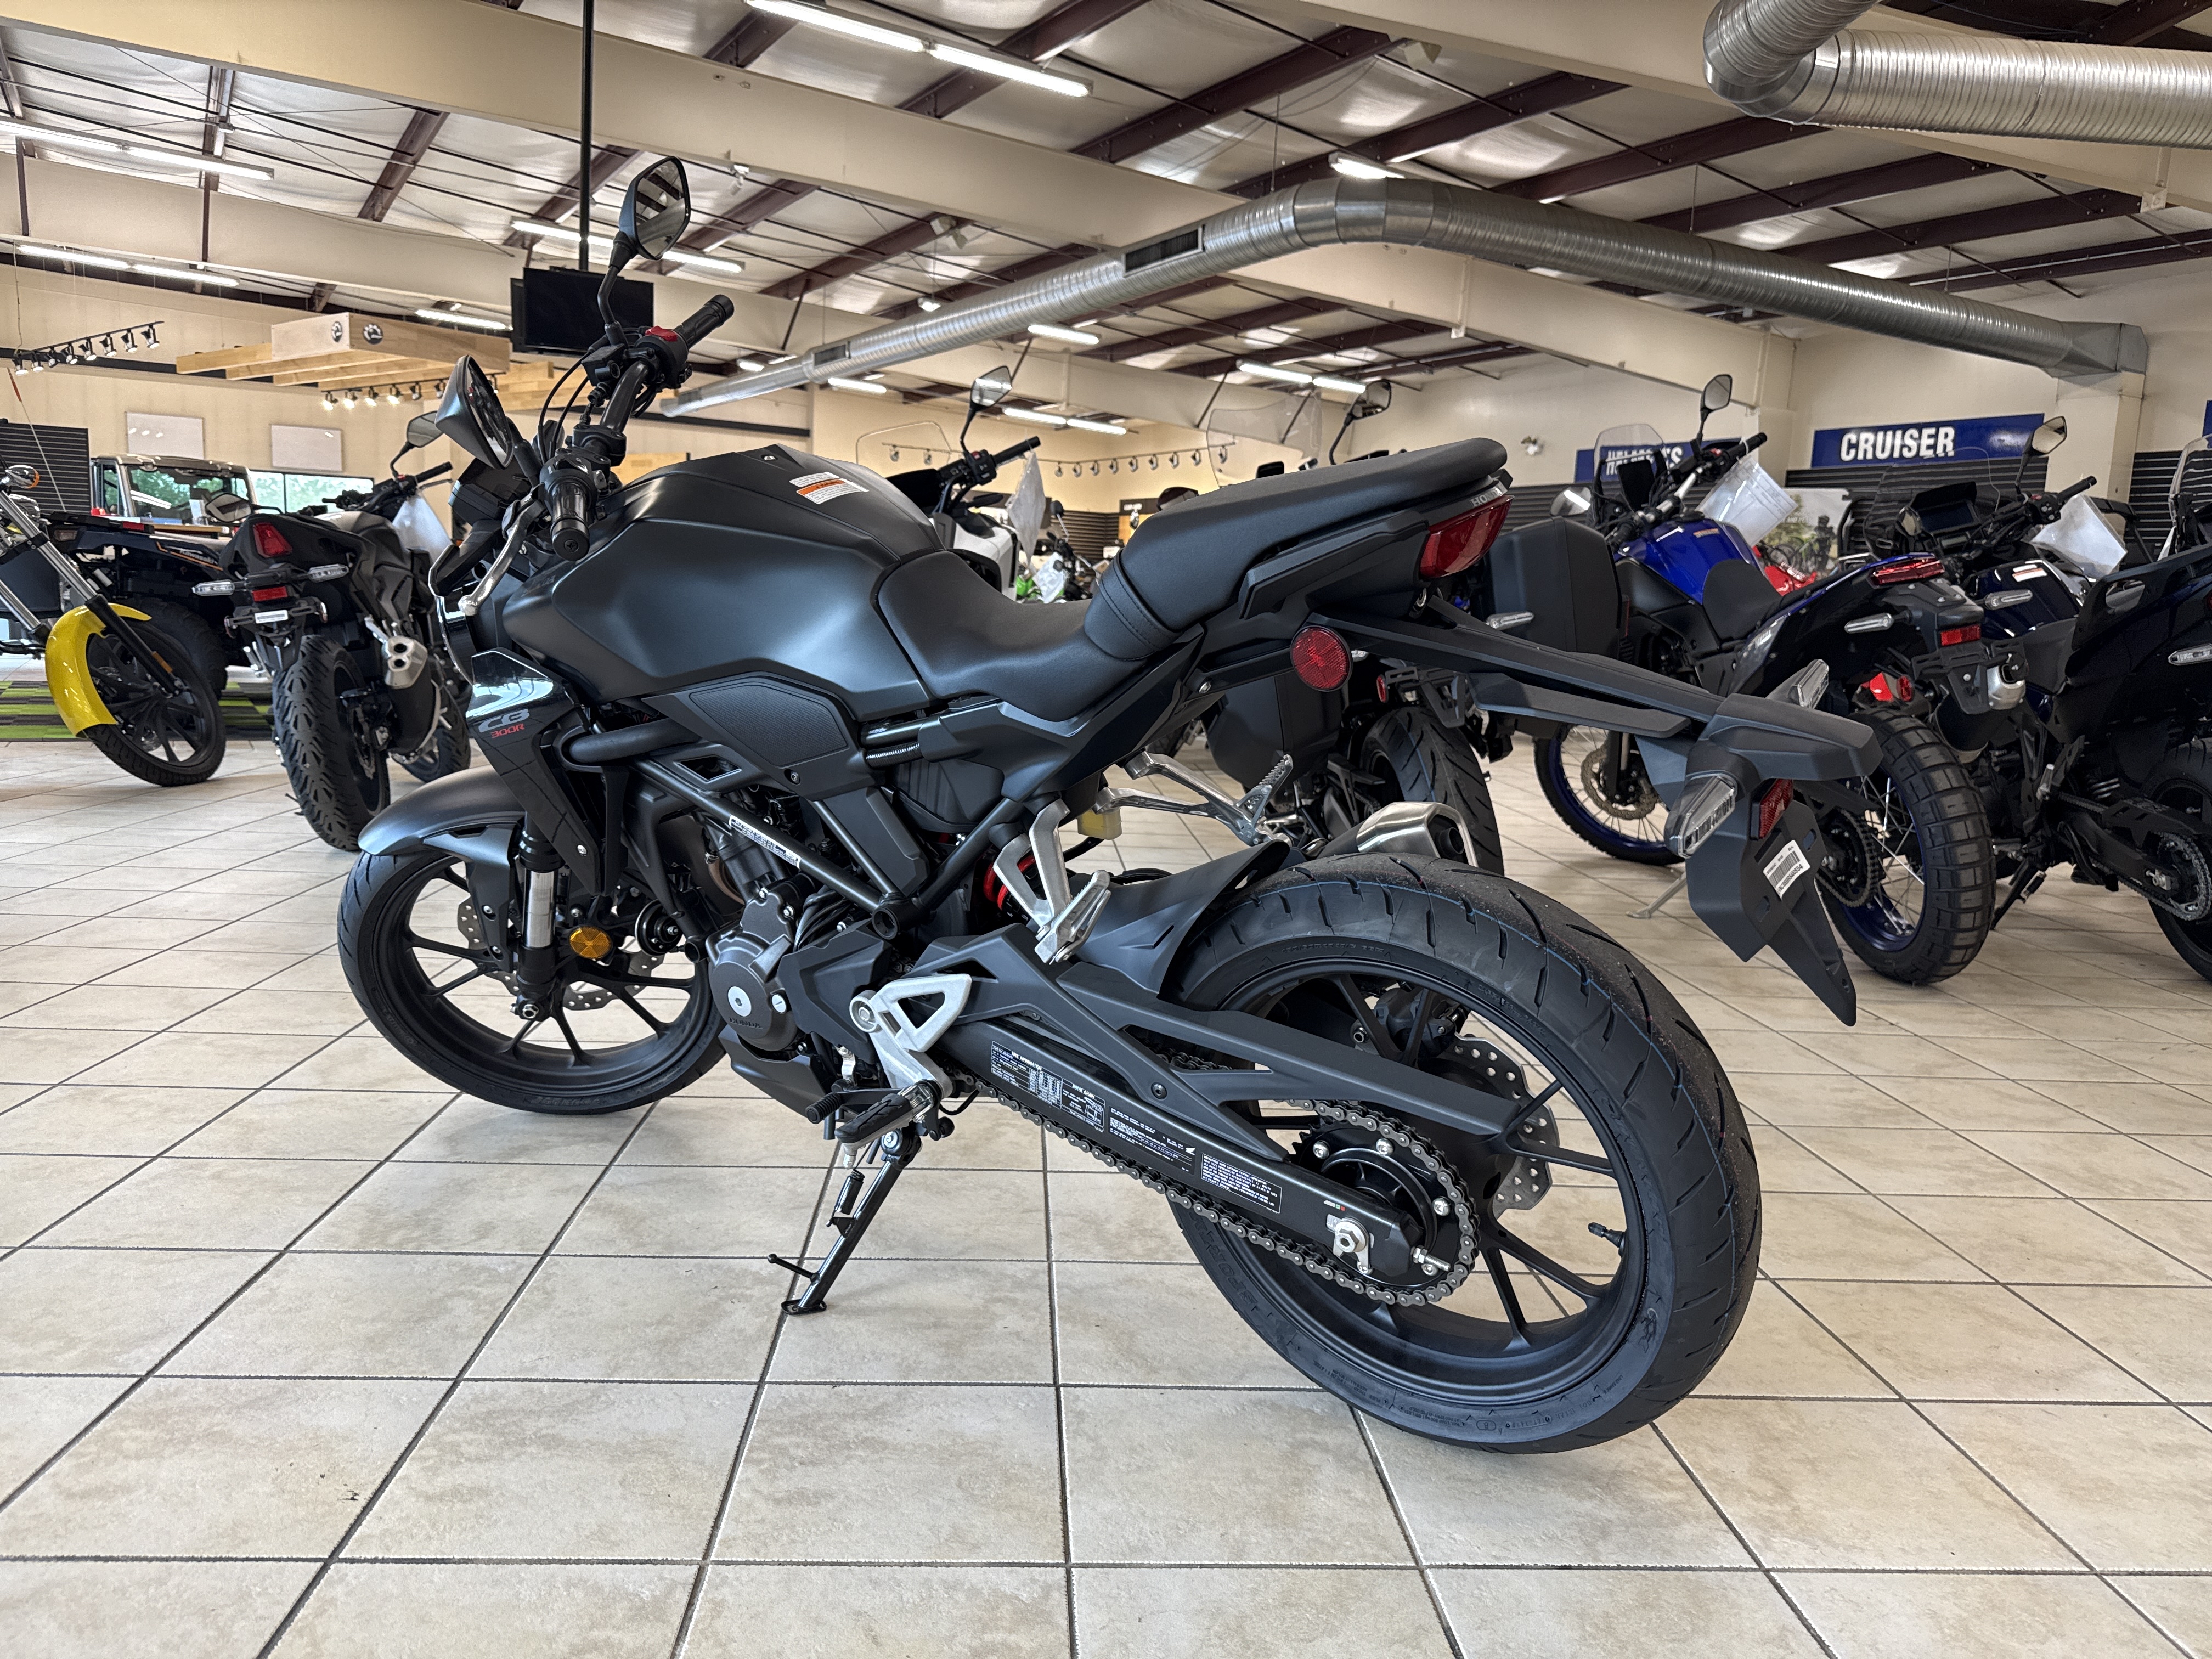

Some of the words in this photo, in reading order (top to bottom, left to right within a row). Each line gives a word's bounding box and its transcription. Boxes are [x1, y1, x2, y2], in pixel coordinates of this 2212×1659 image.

[1840, 426, 1956, 462] CRUISER
[1470, 487, 1503, 507] HONDA
[478, 708, 530, 733] CB
[491, 723, 525, 738] 300R
[1482, 1421, 1489, 1430] B
